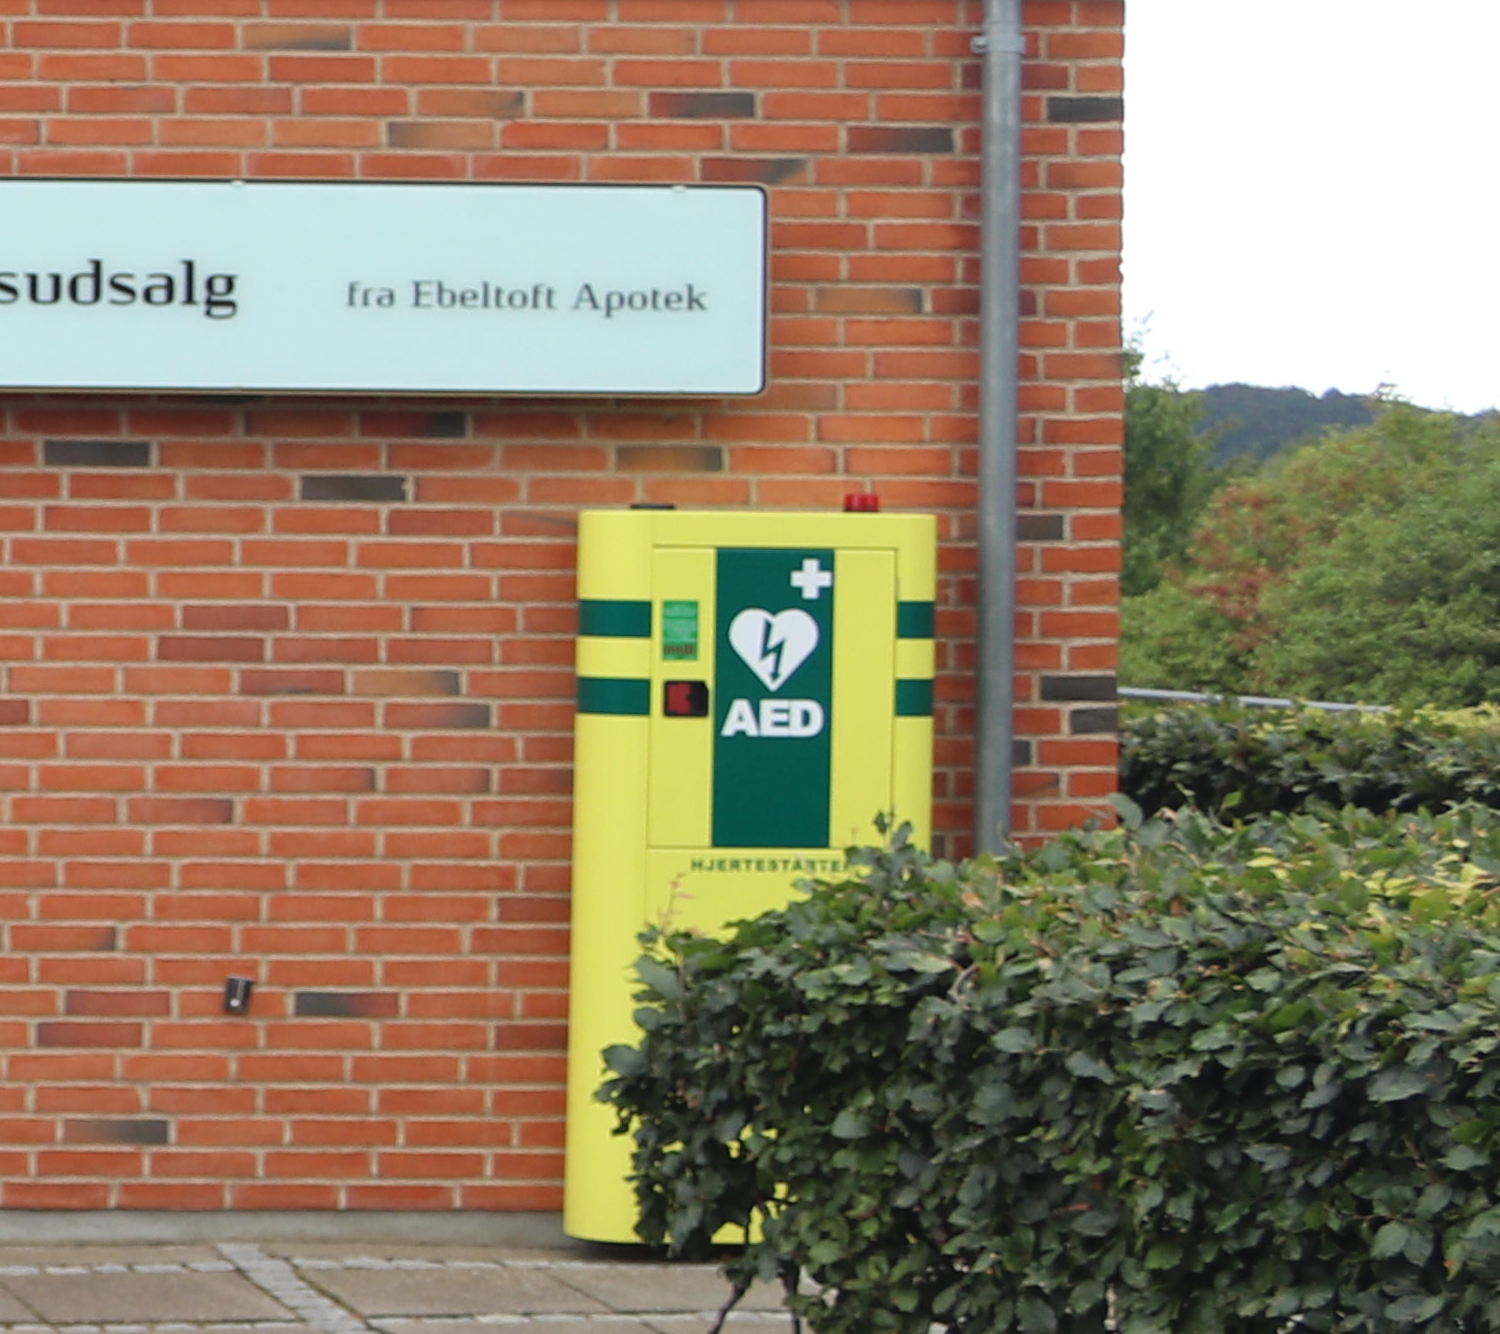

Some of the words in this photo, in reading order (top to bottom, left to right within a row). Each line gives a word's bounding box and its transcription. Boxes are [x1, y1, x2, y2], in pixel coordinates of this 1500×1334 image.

[345, 279, 396, 309] fra
[411, 279, 558, 311] Ebeltoft
[571, 281, 708, 319] Apotek
[720, 698, 825, 738] AED
